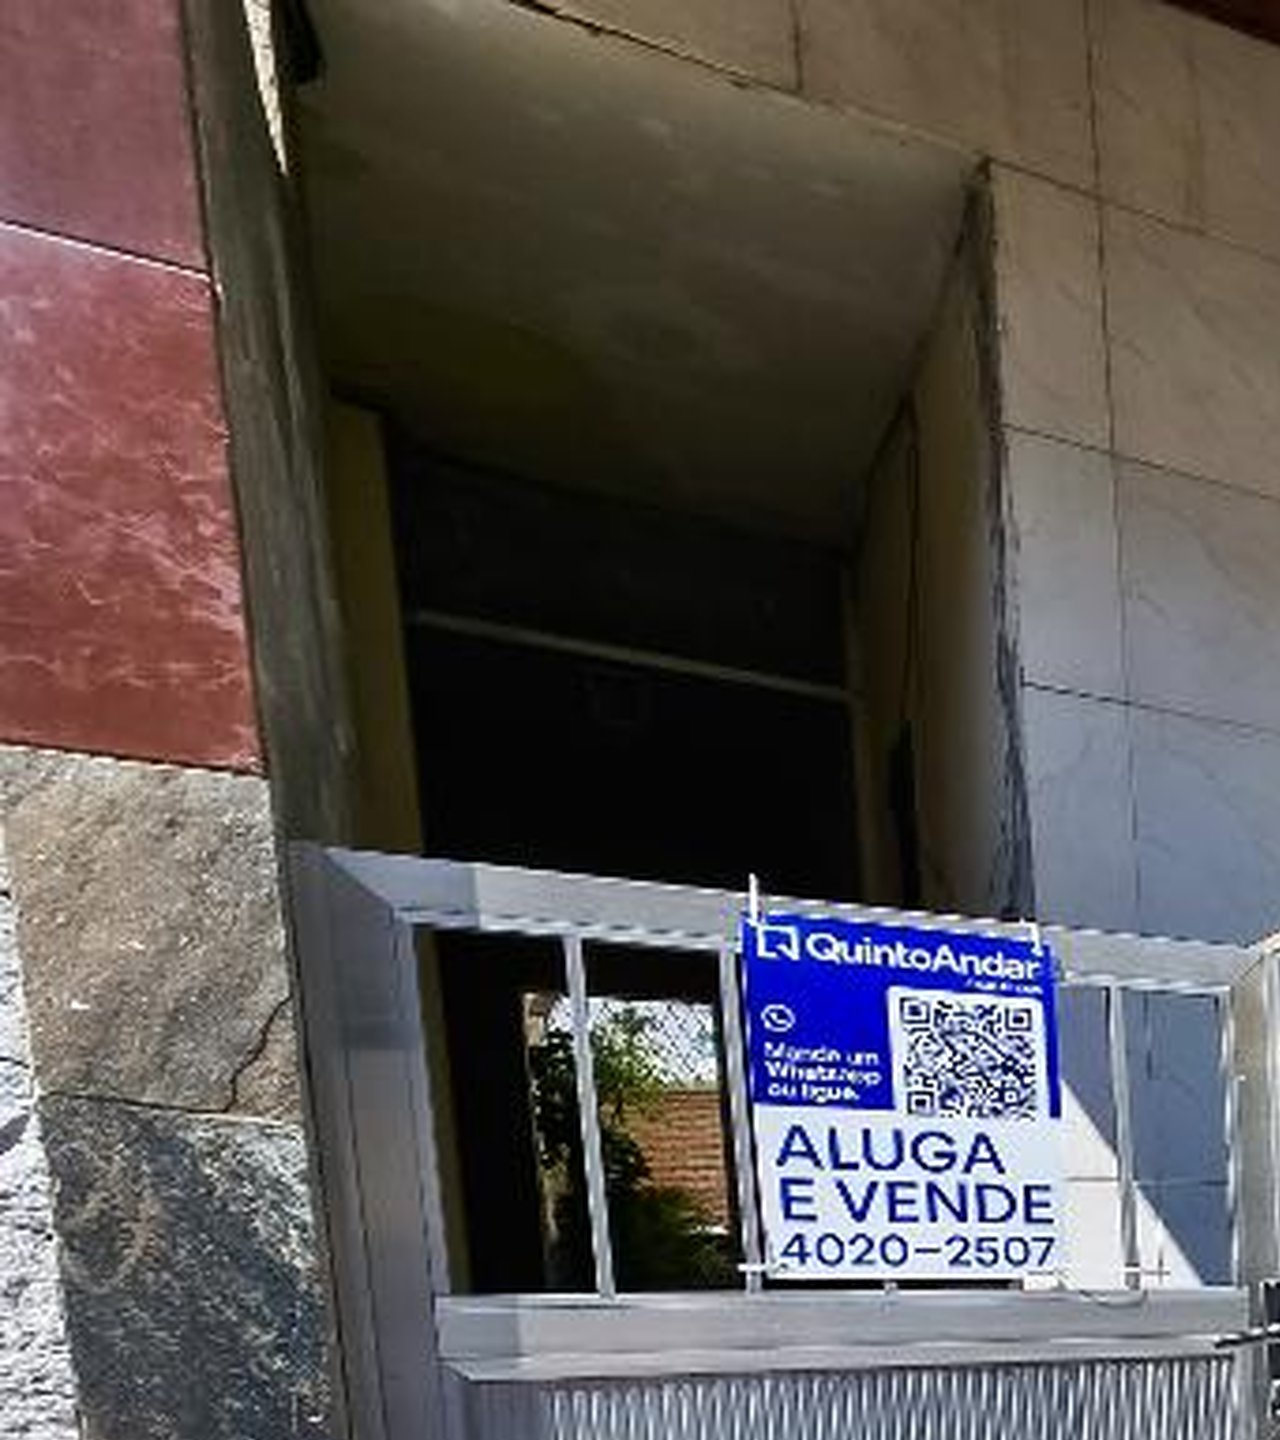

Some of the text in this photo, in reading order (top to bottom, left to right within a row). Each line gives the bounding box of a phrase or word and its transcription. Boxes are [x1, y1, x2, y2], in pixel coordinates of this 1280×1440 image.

[805, 932, 1040, 979] QuintoAndar
[768, 1082, 797, 1099] ou
[775, 1124, 1005, 1174] ALUGA
[781, 1178, 1055, 1225] E VENDE
[781, 1232, 1056, 1267] 4020-2507
